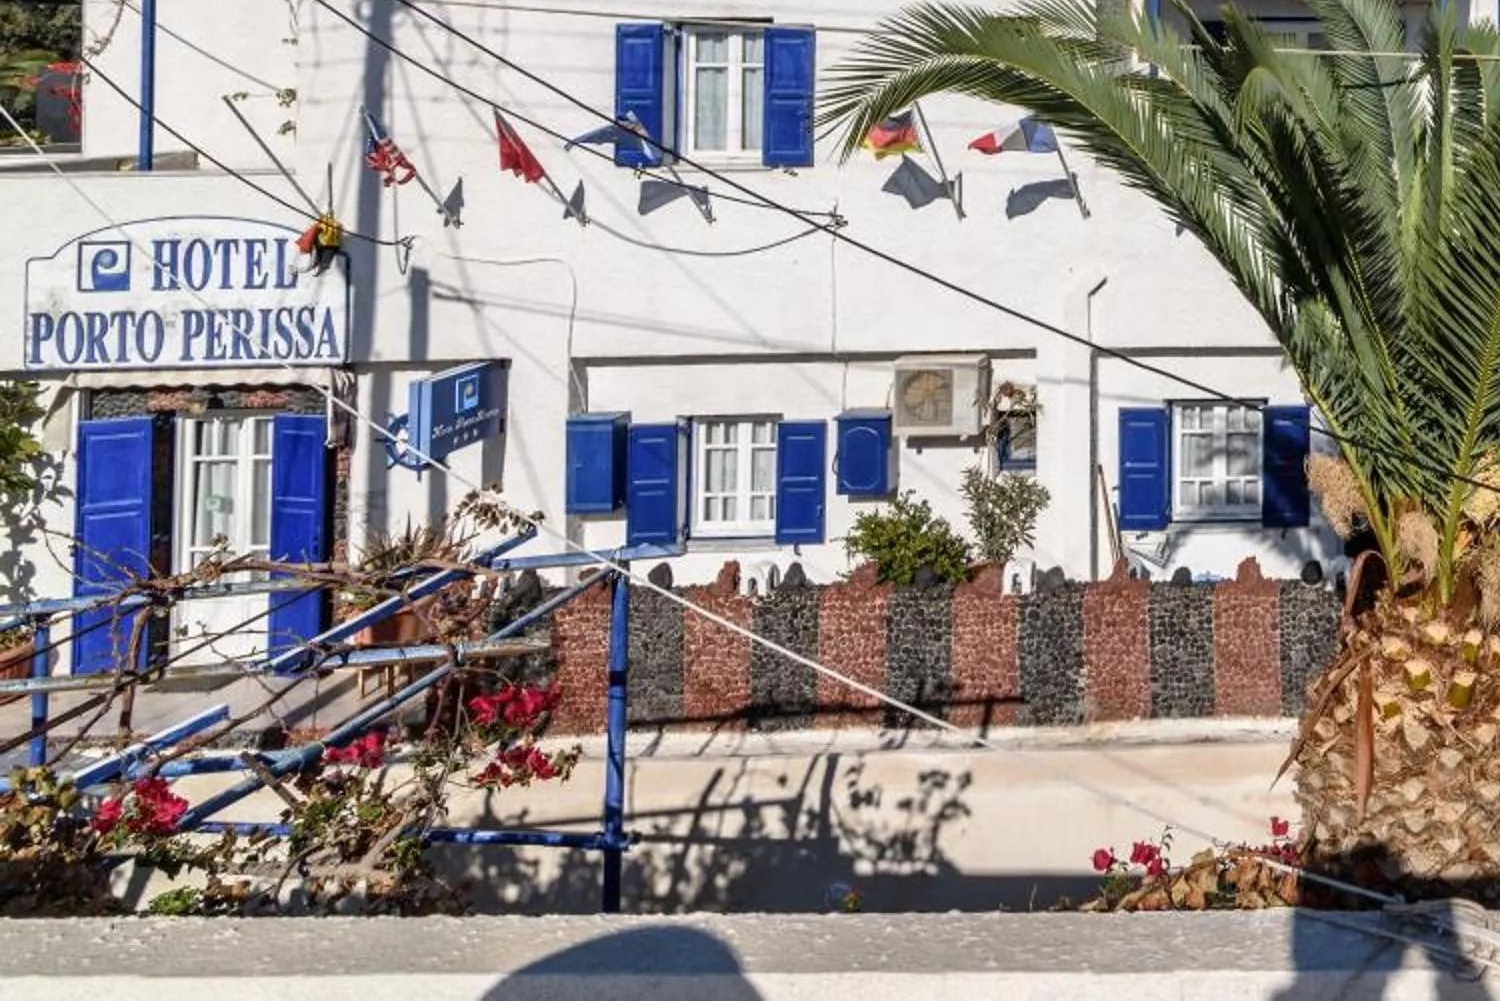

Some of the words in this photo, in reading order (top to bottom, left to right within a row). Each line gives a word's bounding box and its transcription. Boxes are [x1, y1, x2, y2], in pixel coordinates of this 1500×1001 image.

[152, 238, 299, 291] HOTEL
[29, 311, 165, 365] PORTO
[179, 307, 341, 361] PERISSA
